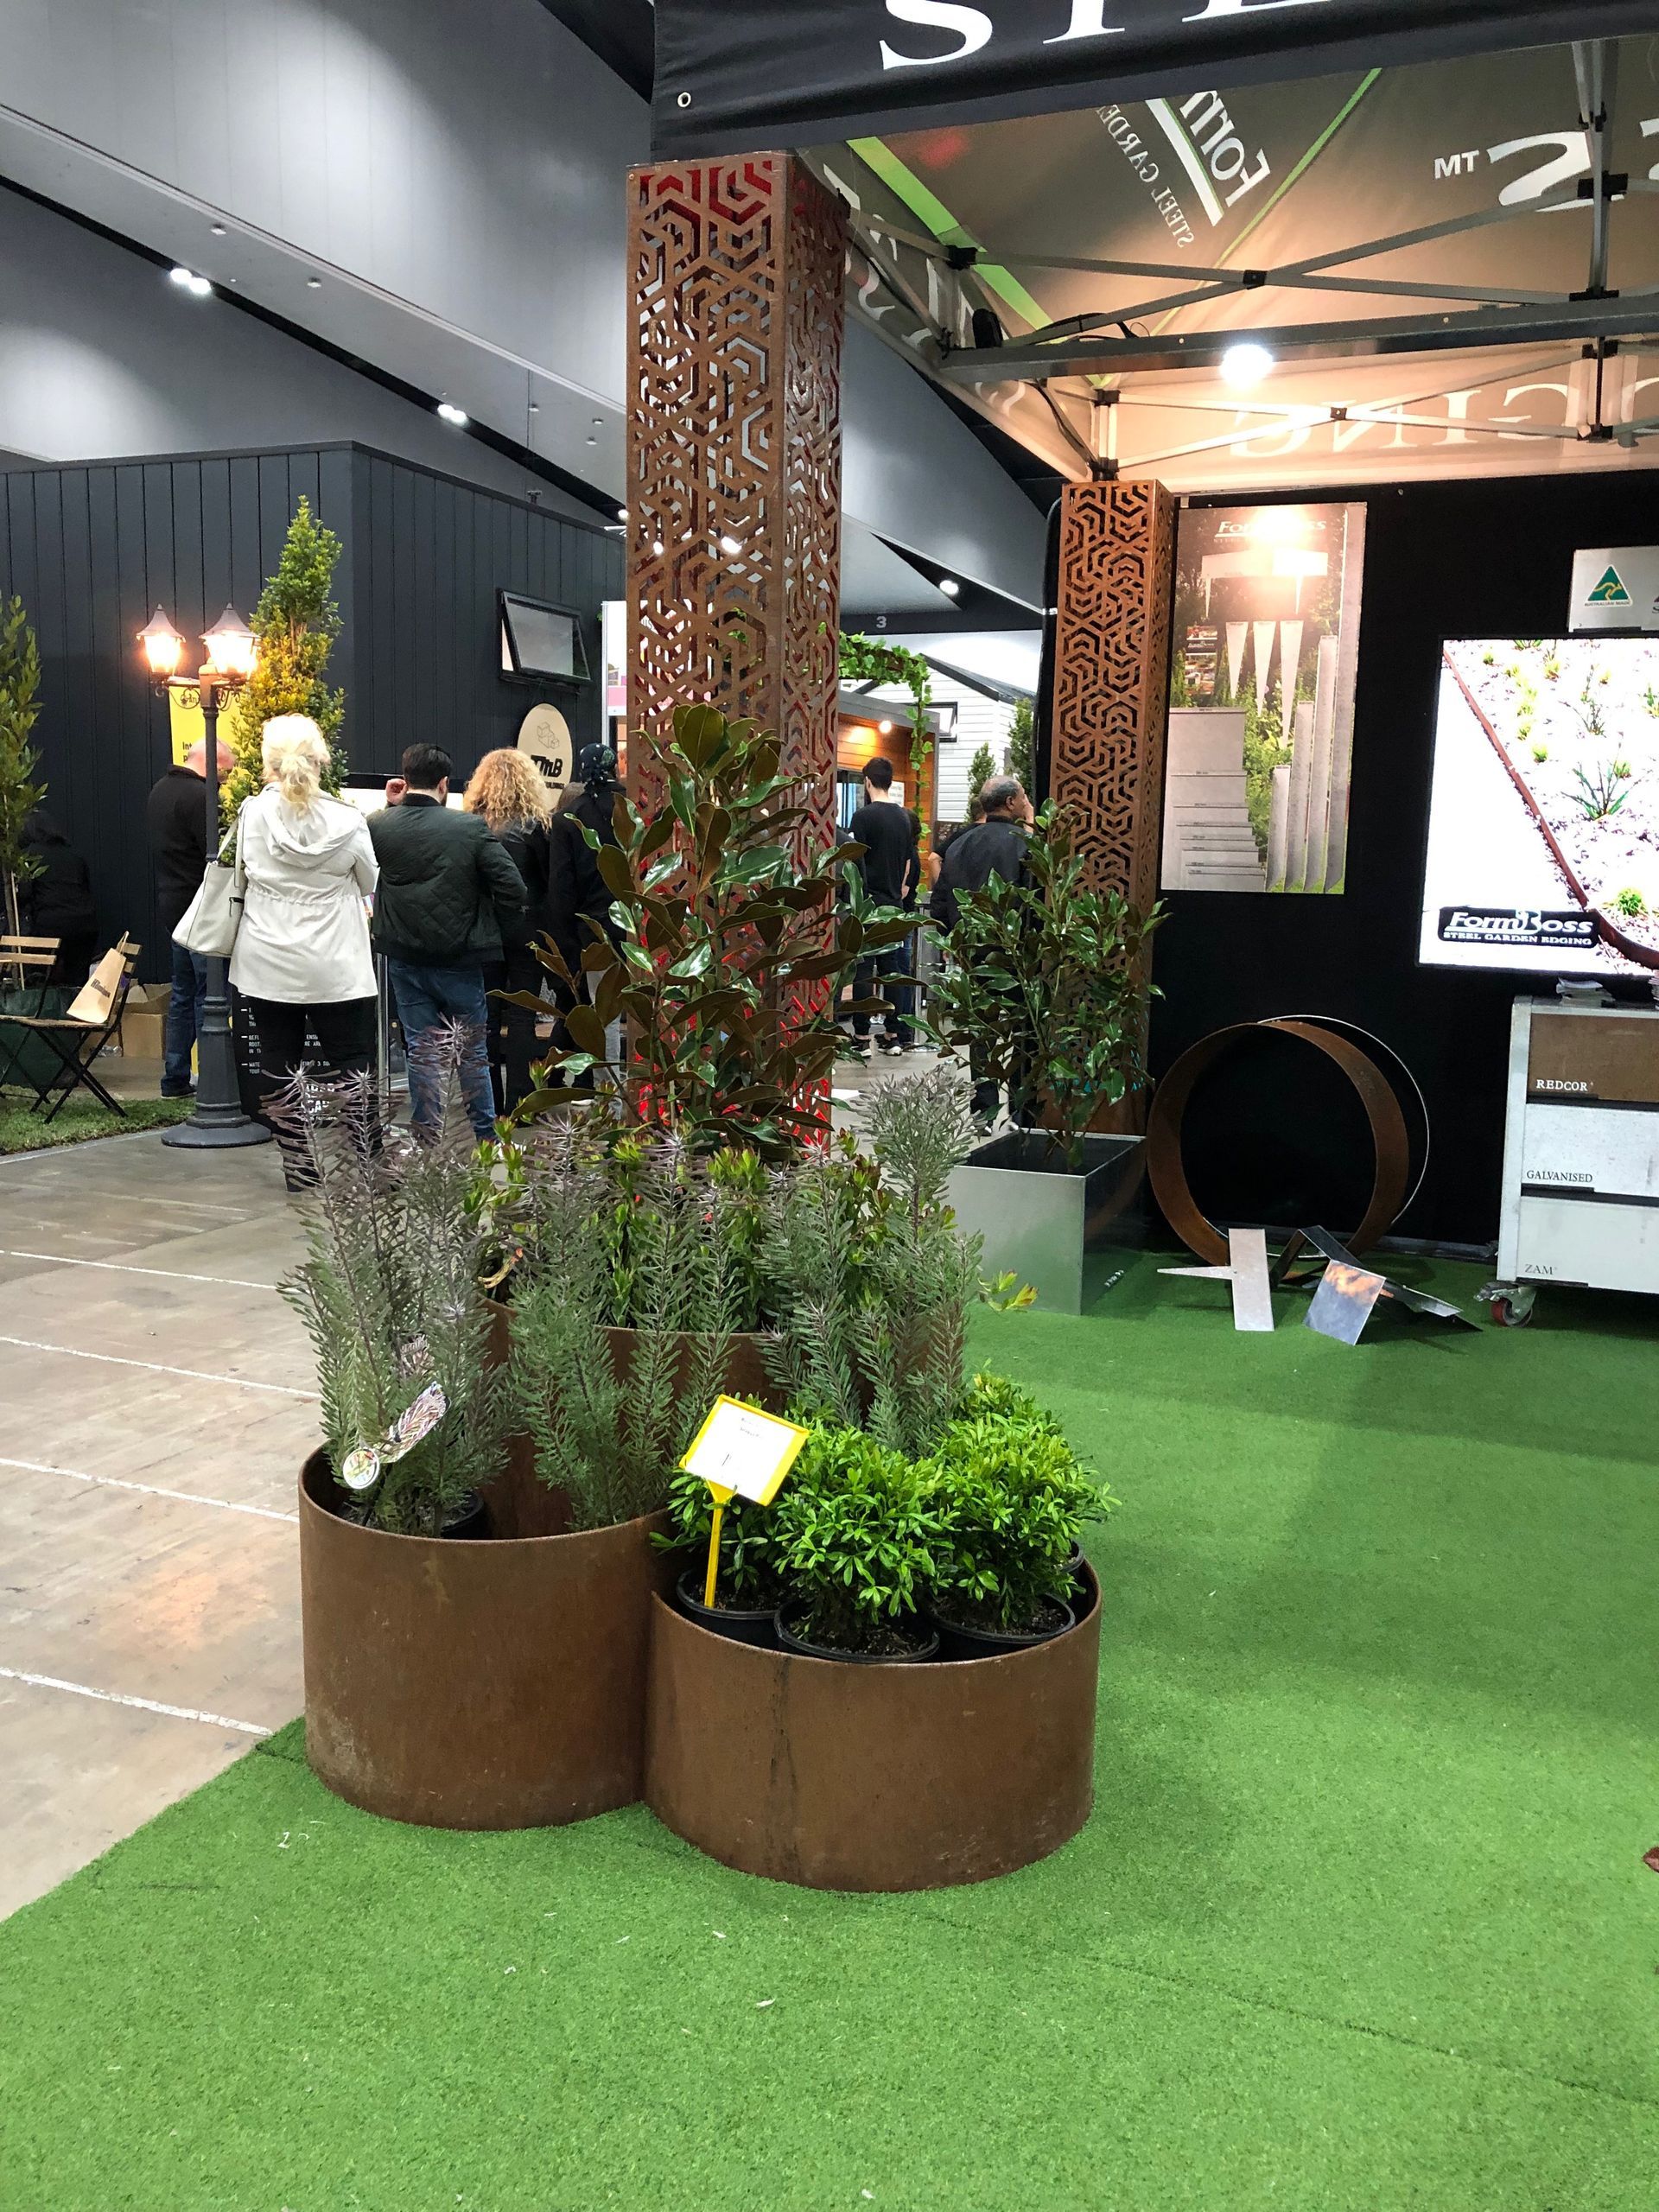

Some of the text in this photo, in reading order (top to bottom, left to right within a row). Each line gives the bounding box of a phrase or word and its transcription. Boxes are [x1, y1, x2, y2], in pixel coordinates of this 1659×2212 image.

[876, 615, 887, 629] 3
[1448, 909, 1593, 934] FormBoss
[1484, 933, 1538, 943] GARDEN
[1541, 936, 1592, 945] EDGING
[1536, 1079, 1588, 1091] REDCOR
[1526, 1170, 1593, 1183] GALVANISED
[1525, 1264, 1554, 1275] ZAM
